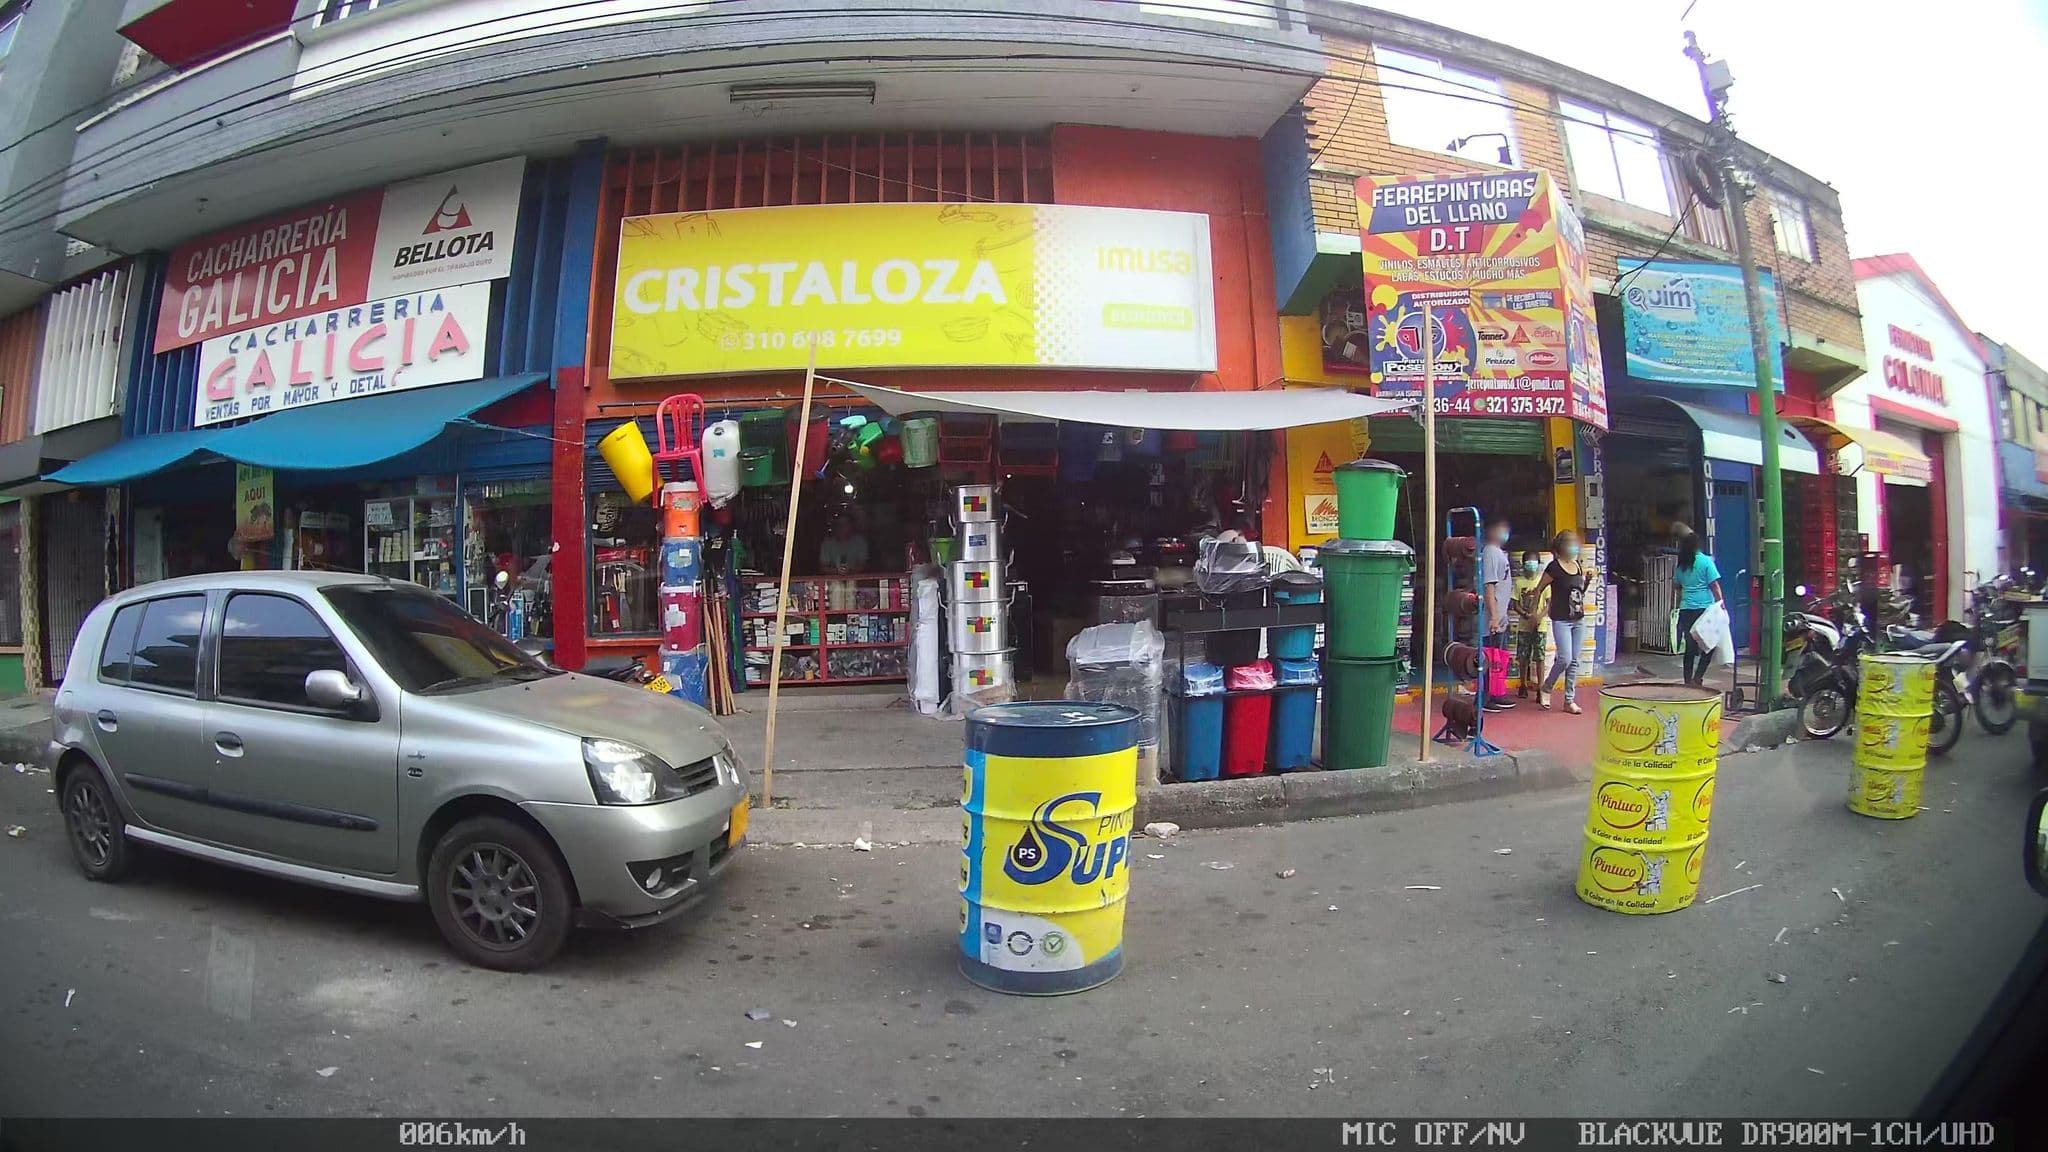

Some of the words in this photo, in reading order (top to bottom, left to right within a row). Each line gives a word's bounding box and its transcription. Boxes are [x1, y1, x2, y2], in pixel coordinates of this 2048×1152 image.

[1372, 178, 1536, 208] FERREPINTURAS
[1405, 206, 1442, 226] DEL
[1448, 202, 1508, 223] LLANO
[186, 204, 349, 283] CACHARRERÍA
[393, 231, 494, 268] BELLOTA
[1430, 226, 1471, 252] D.T
[1096, 246, 1193, 277] imusa
[1472, 269, 1505, 281] MUCHO
[178, 246, 339, 339] GALICIA
[623, 259, 1009, 315] CRISTALOZA
[1411, 290, 1469, 300] DISTRIBUIDOR
[1413, 298, 1471, 308] AUTORIZADO
[228, 293, 445, 355] CACHARRERIA
[741, 331, 786, 351] 310
[842, 328, 902, 350] 7699
[205, 311, 471, 401] GALICIA
[204, 402, 240, 421] VENTAS
[251, 395, 271, 412] POR
[283, 386, 320, 406] MAYOR
[331, 382, 339, 397] Y
[349, 374, 387, 395] DETAL
[1486, 397, 1508, 413] 321
[1511, 397, 1533, 413] 375
[1535, 397, 1566, 414] 3472
[1609, 719, 1652, 737] Pintuco
[1643, 761, 1674, 769] Calidad
[1601, 793, 1643, 813] Pintuco
[1633, 837, 1663, 845] Calidad
[1018, 848, 1036, 859] PS
[1595, 857, 1636, 878] Pintuco
